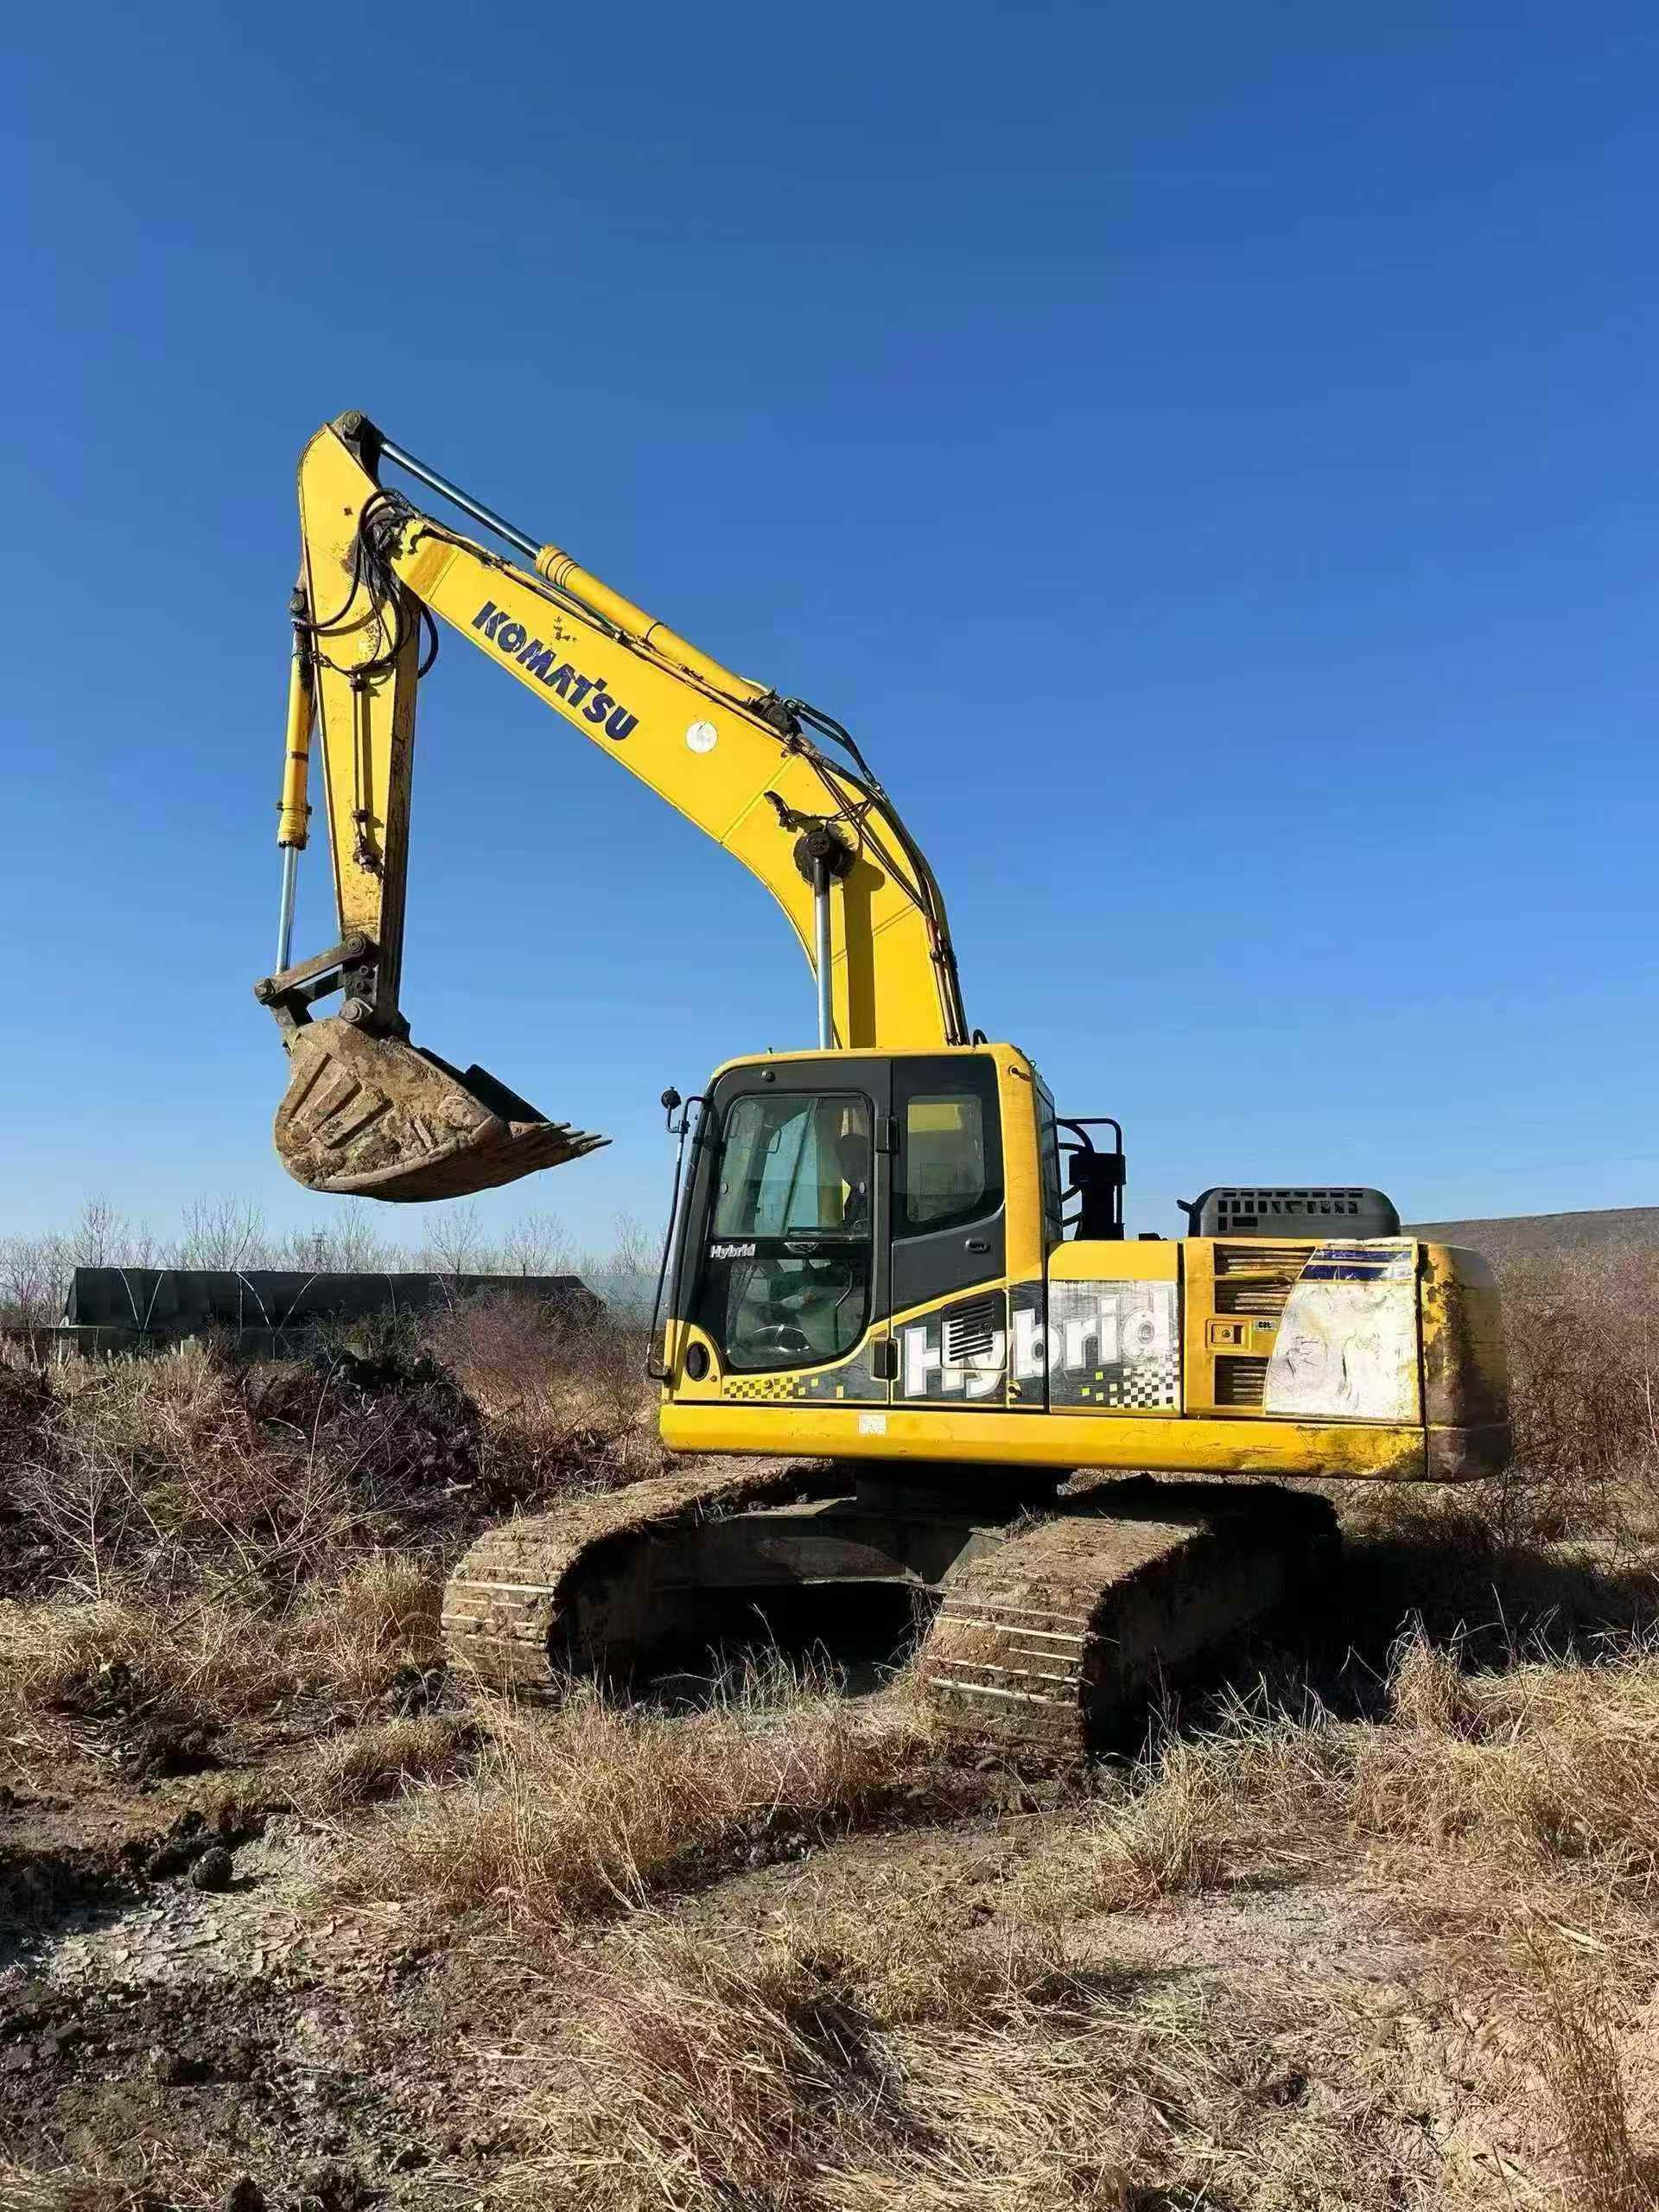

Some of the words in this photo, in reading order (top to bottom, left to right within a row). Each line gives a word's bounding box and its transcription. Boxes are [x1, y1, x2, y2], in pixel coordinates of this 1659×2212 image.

[471, 601, 639, 741] KOMATSU
[710, 1243, 756, 1260] Hybrid
[904, 1284, 1176, 1399] Hybrid
